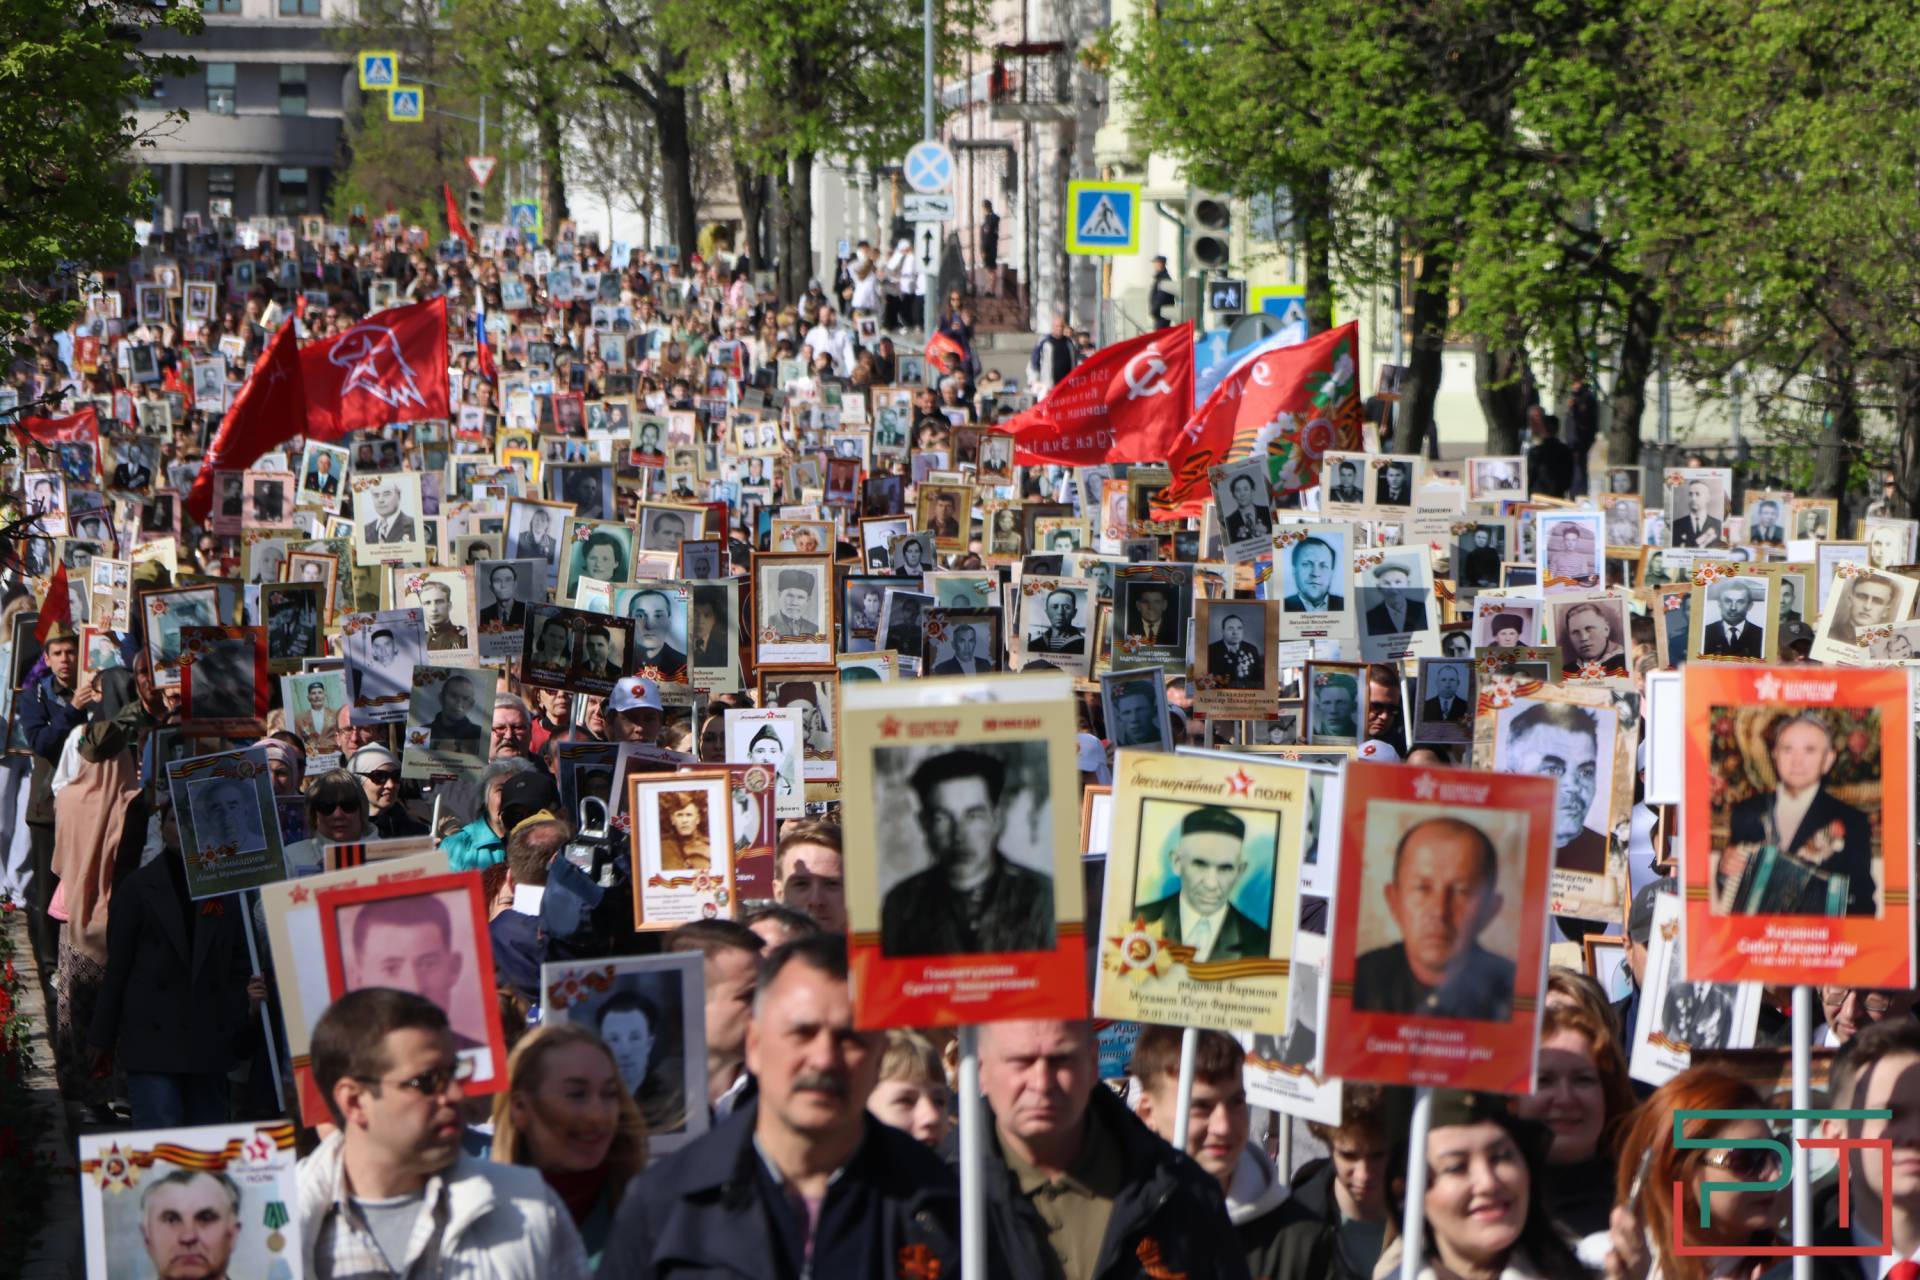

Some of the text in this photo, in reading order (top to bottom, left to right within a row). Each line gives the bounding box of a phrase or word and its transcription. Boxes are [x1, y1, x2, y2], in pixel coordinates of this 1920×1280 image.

[1253, 787, 1293, 803] ПОЛК
[1177, 980, 1223, 993] рядовой
[1128, 991, 1177, 1005] Мухамет
